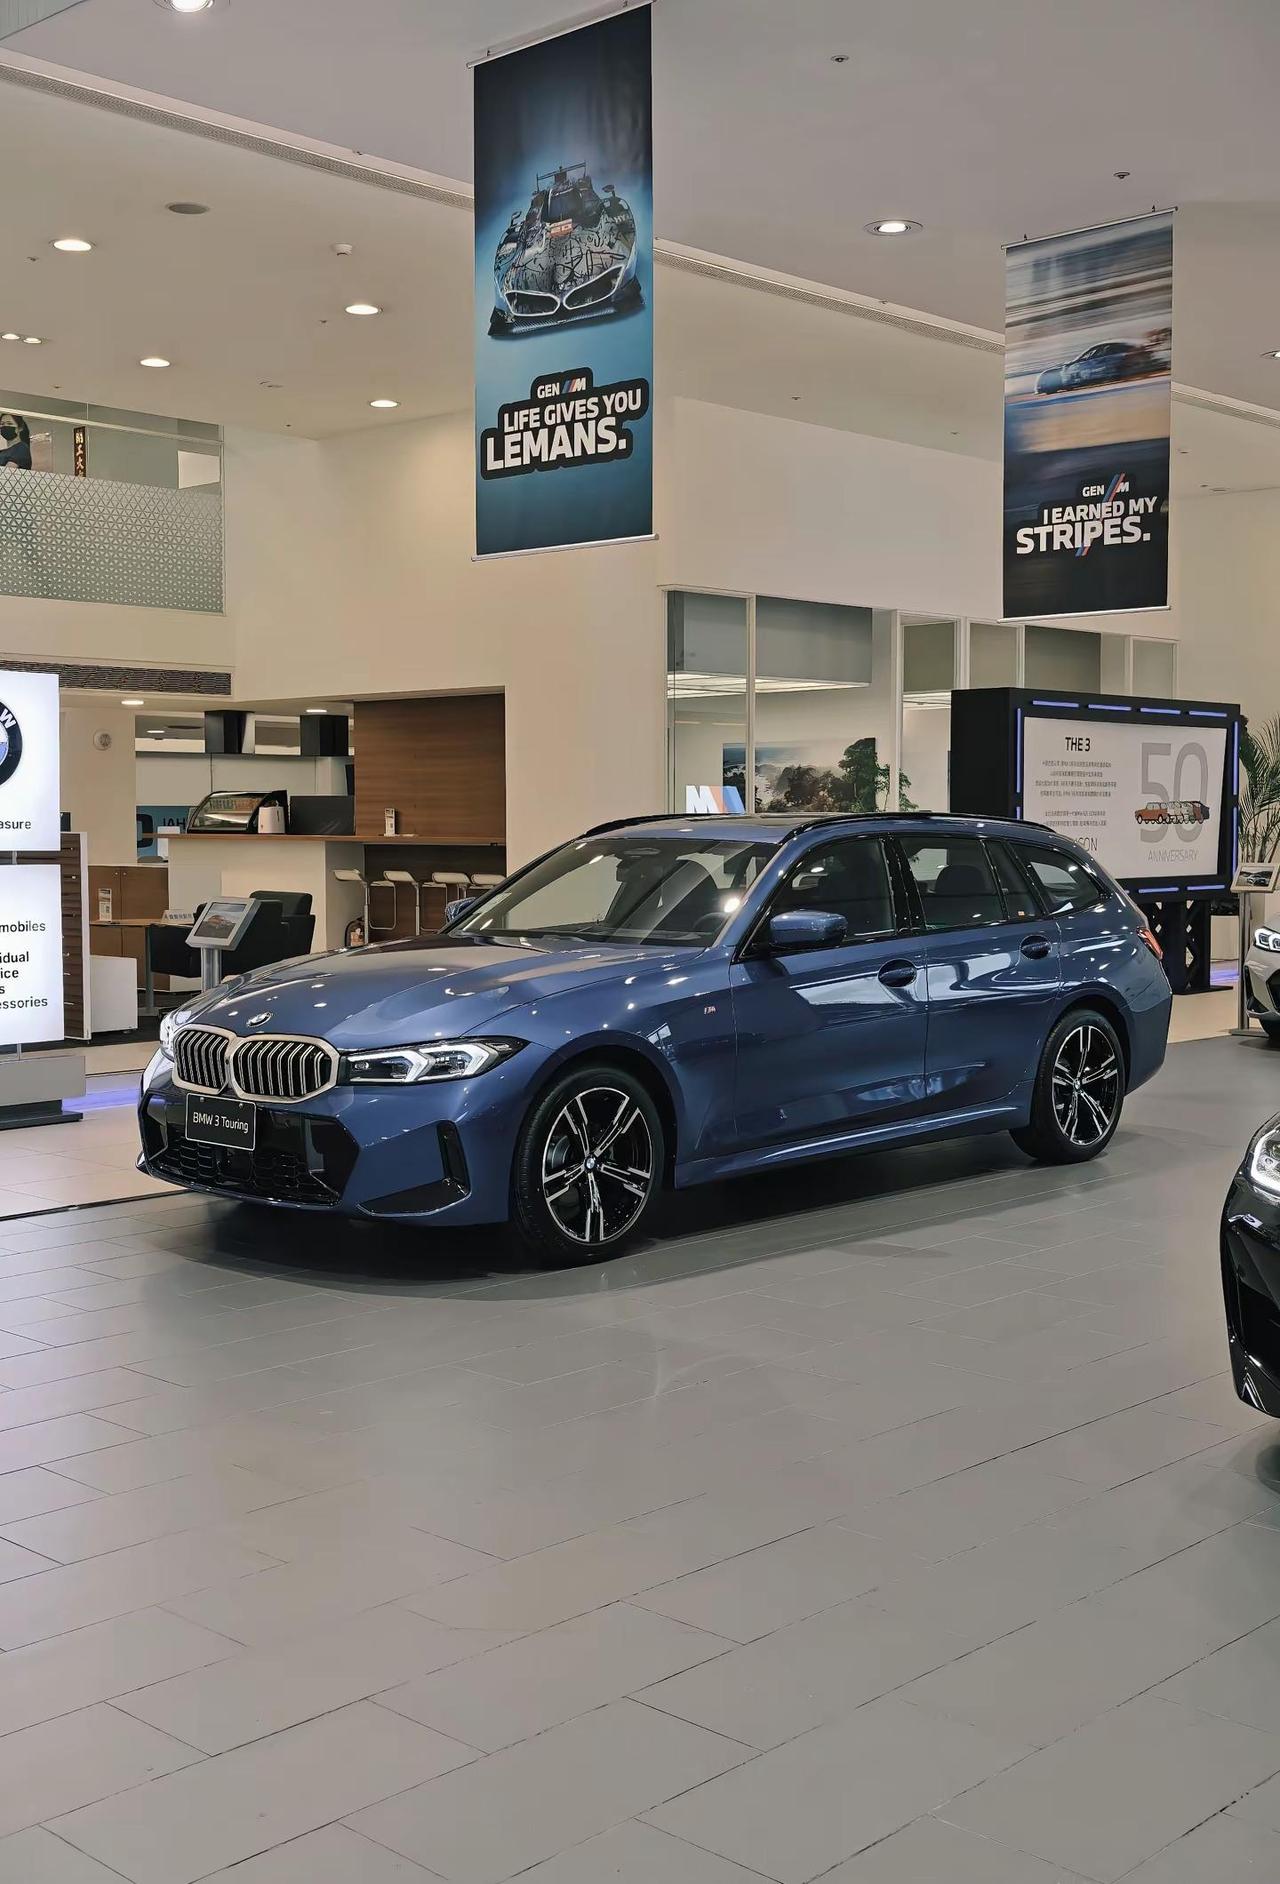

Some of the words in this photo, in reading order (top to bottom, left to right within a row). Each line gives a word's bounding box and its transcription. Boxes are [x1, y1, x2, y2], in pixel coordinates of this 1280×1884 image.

[537, 382, 560, 399] GEN
[504, 407, 540, 433] LIFE
[544, 397, 599, 426] GIVES
[602, 389, 642, 415] YOU
[486, 417, 627, 471] LEMANS.
[1082, 484, 1105, 497] GEN
[1043, 509, 1049, 525] I
[1052, 500, 1125, 524] EARNED
[1129, 496, 1158, 515] MY
[1016, 515, 1151, 555] STRIPES.
[1065, 736, 1083, 752] THE
[1084, 737, 1091, 752] 3
[1141, 742, 1208, 843] 50
[0, 920, 46, 933] mobiles
[0, 996, 48, 1009] ssories
[193, 1111, 213, 1125] BMW
[214, 1114, 220, 1127] 3
[221, 1116, 249, 1134] Touring
